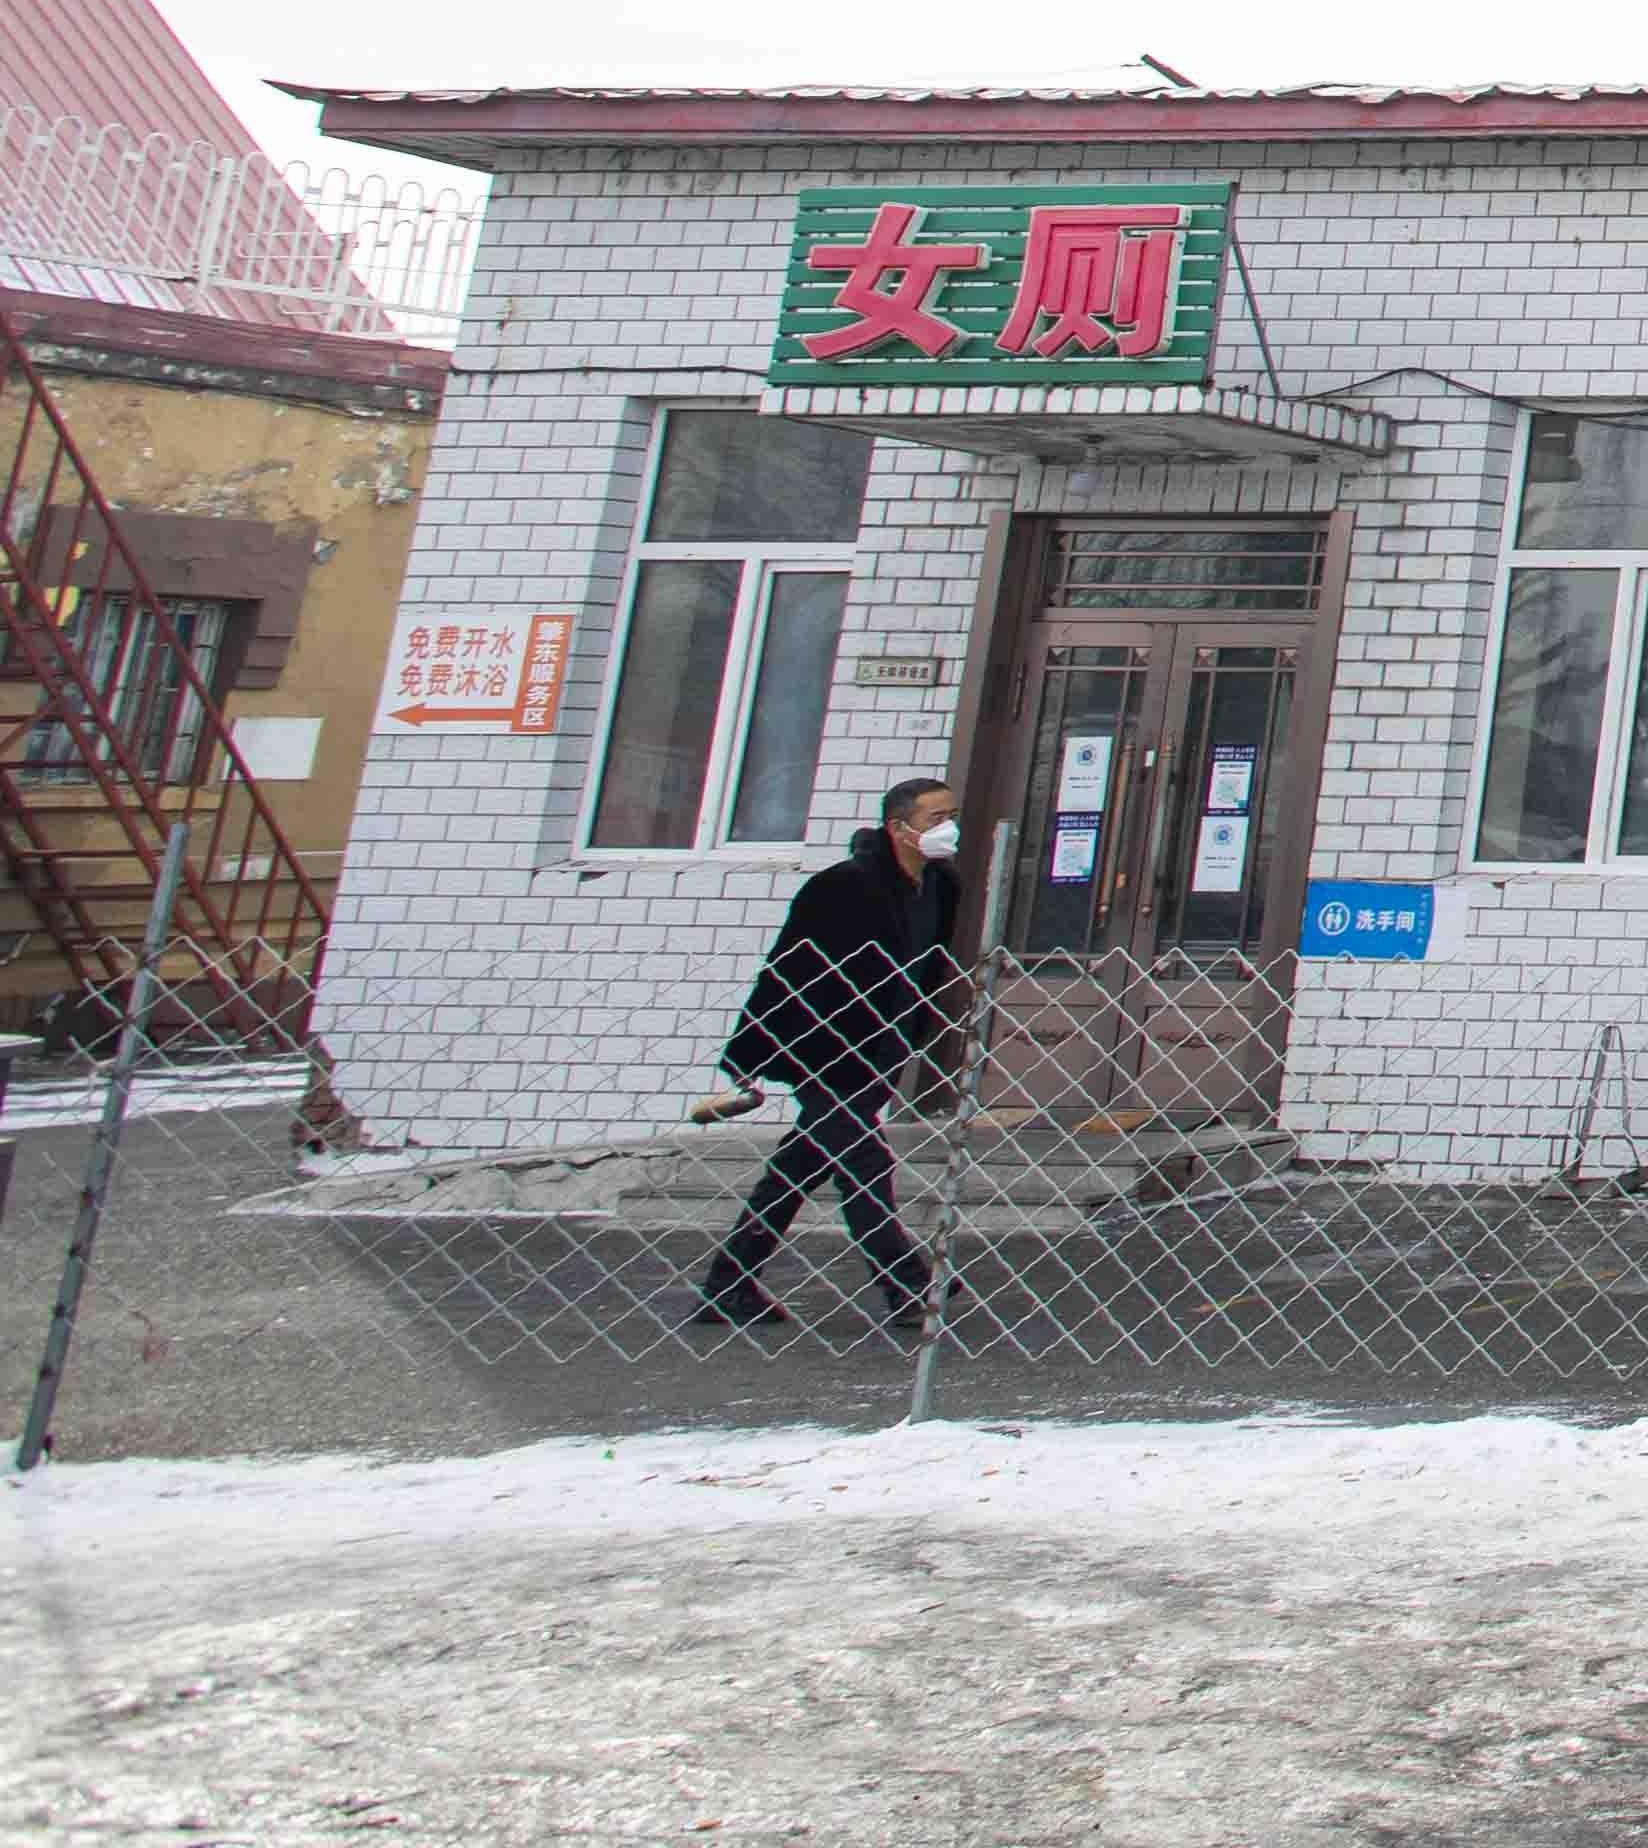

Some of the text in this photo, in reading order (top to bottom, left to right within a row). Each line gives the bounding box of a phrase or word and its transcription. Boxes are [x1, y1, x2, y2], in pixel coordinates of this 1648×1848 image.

[801, 202, 1192, 360] 女厕
[406, 625, 516, 660] 免费开水
[397, 663, 509, 698] 免费沐浴
[1355, 909, 1415, 933] 洗手间
